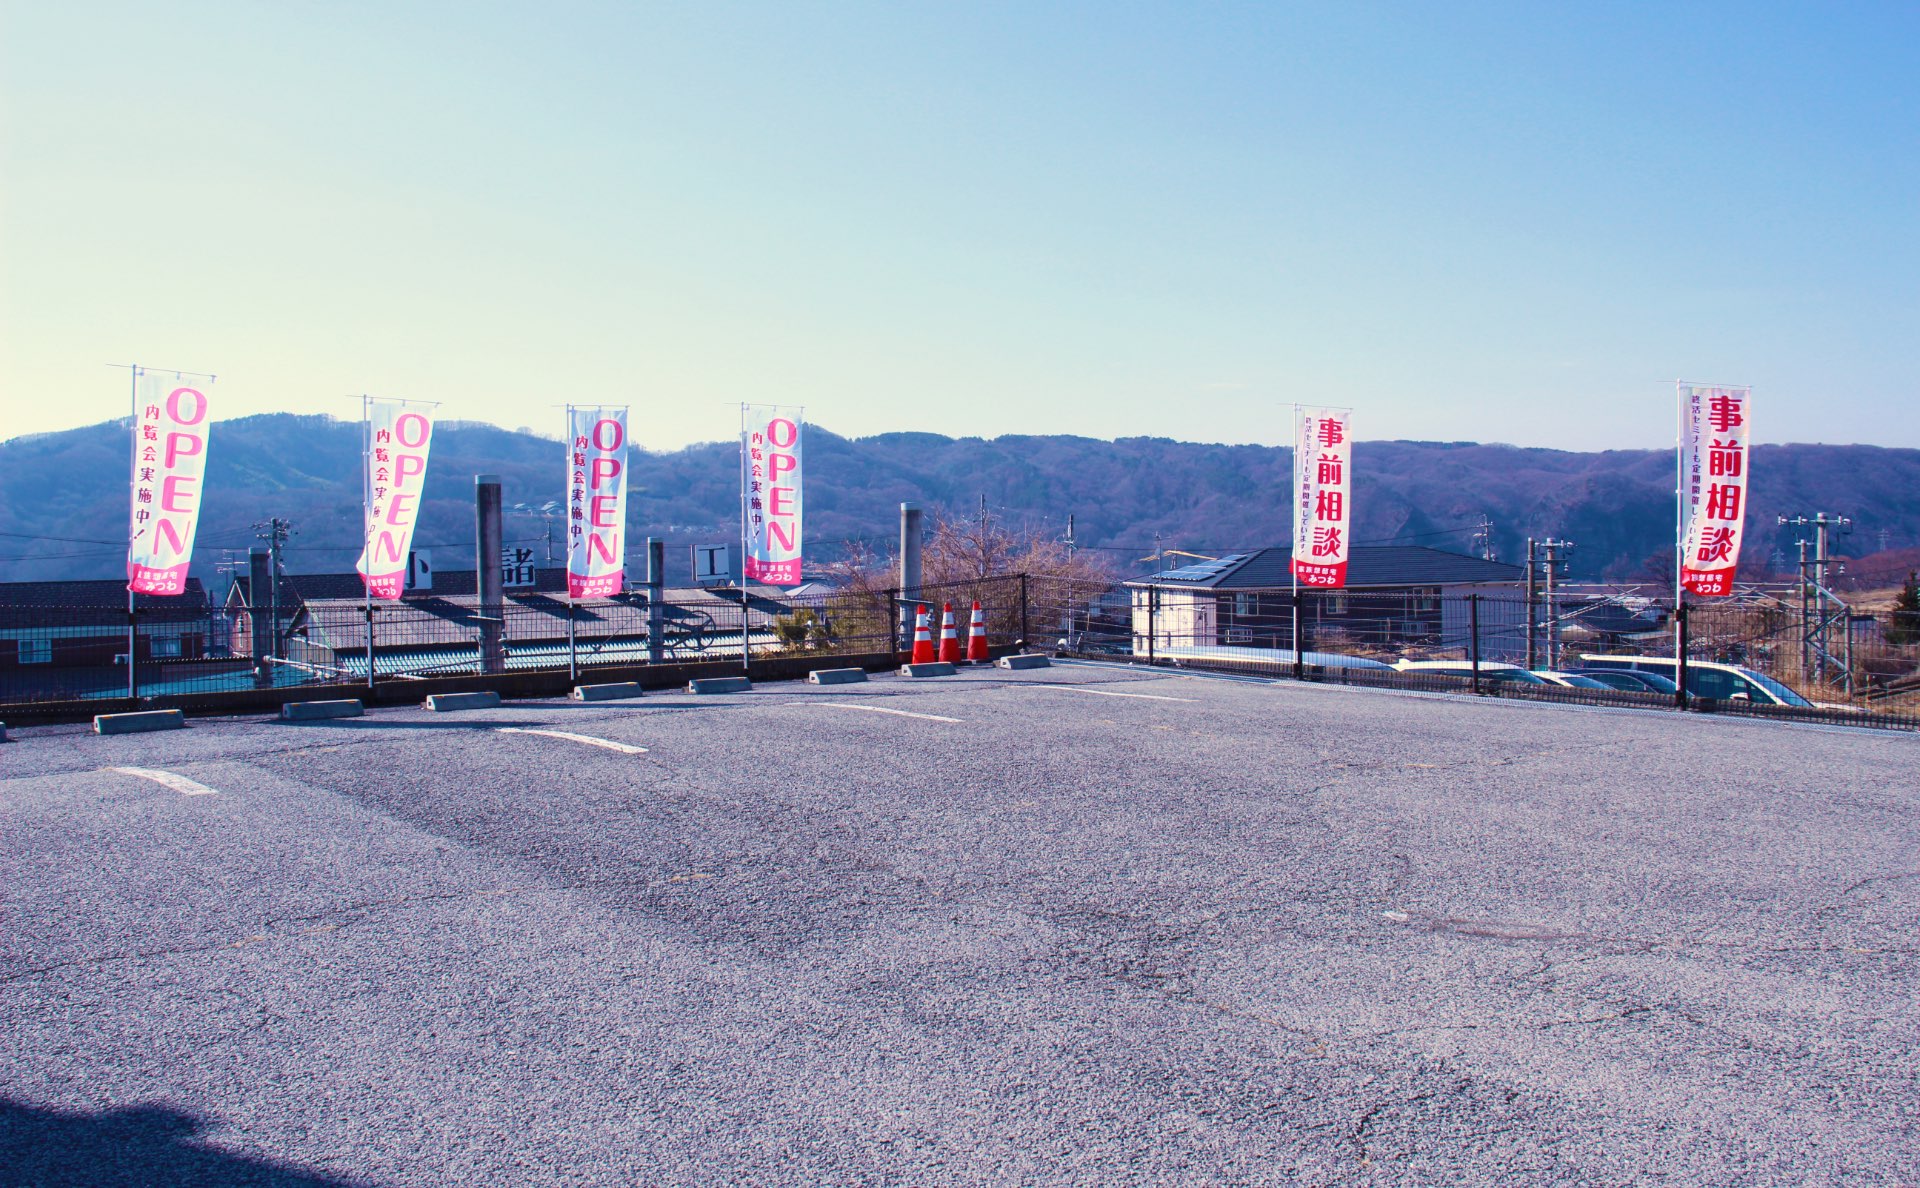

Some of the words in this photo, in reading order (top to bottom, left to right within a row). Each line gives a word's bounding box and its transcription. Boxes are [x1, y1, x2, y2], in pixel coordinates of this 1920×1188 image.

[133, 404, 160, 539] 内覧会実施中！
[153, 387, 208, 556] OPEN
[374, 413, 430, 563] OPEN
[587, 419, 623, 565] OPEN
[767, 418, 797, 551] OPEN
[1312, 417, 1344, 558] 事前相談
[1697, 395, 1743, 563] 事前相談
[145, 580, 177, 591] みつわ
[582, 586, 612, 595] みつわ
[764, 572, 793, 581] みつわ
[1309, 574, 1336, 584] みつわ
